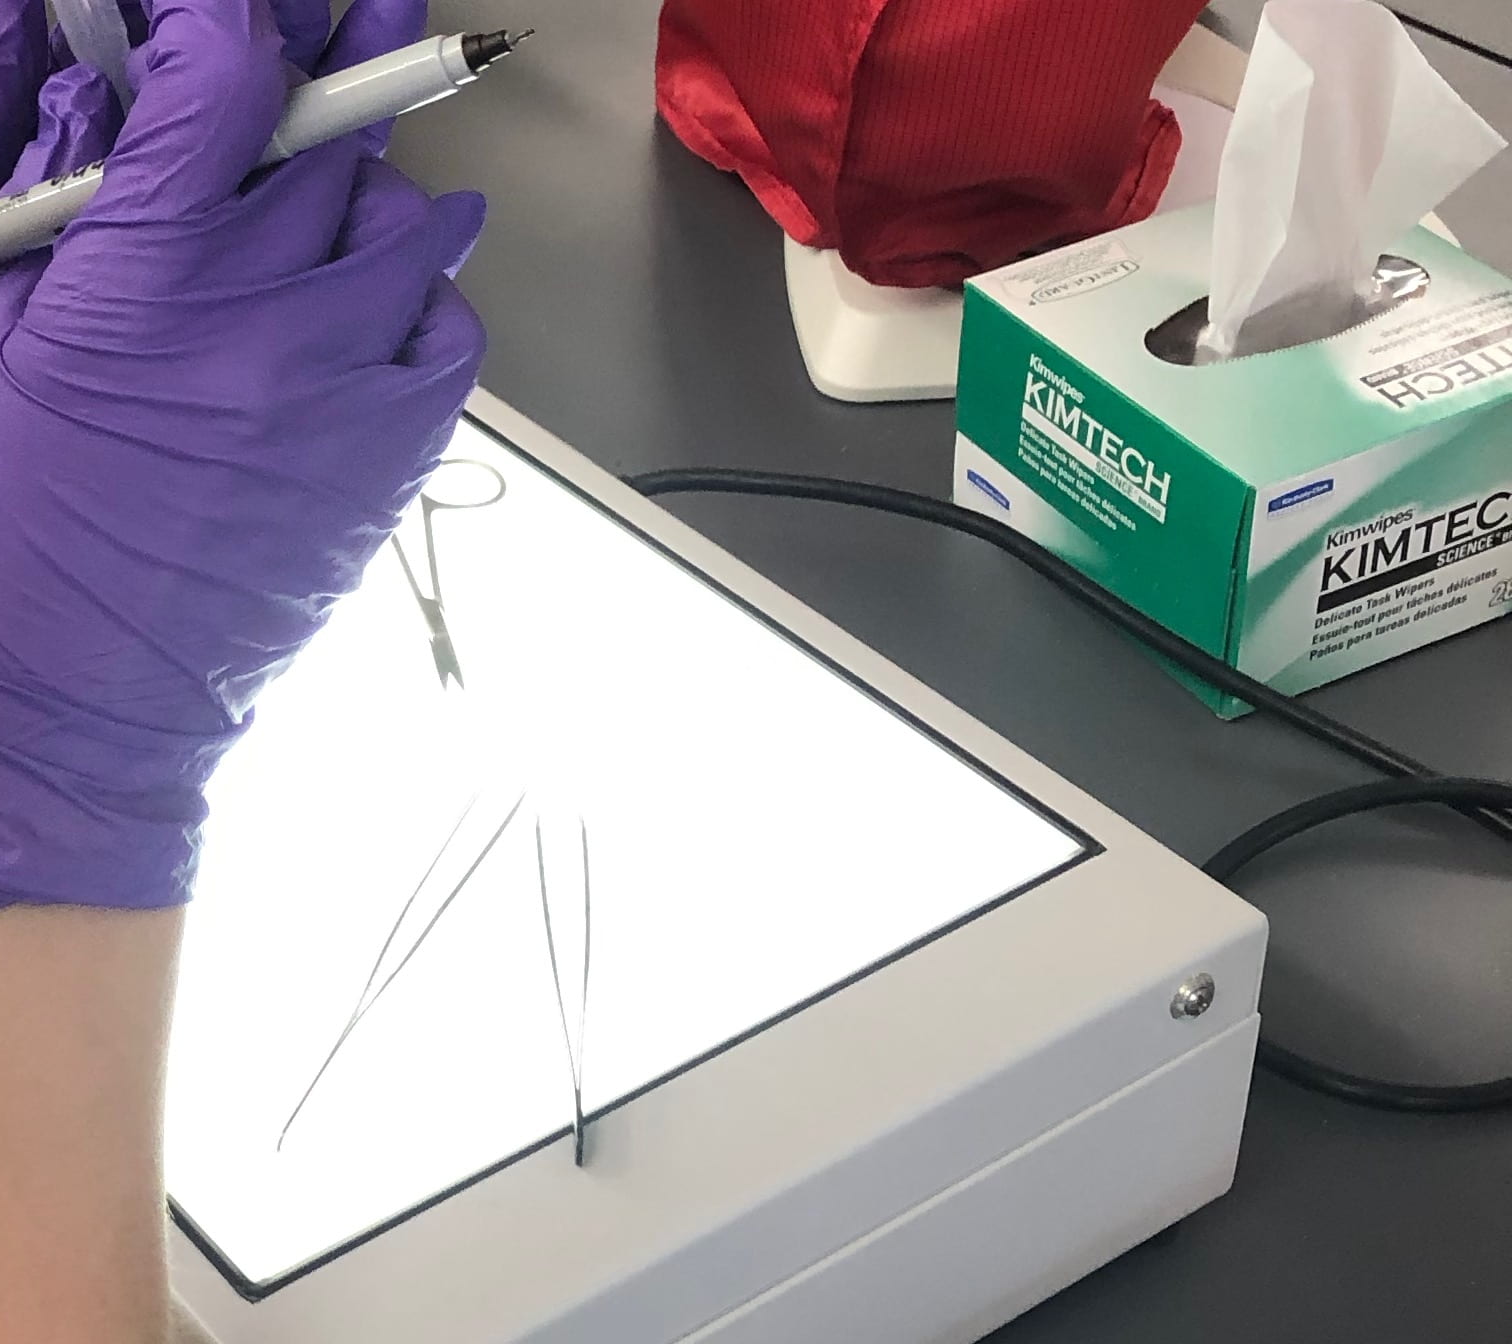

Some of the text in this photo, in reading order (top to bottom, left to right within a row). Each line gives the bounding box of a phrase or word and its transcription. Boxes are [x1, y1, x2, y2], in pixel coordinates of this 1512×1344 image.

[1030, 353, 1085, 404] Kimwipes
[1377, 346, 1512, 408] TECH
[1024, 371, 1171, 505] KIMTECH
[1095, 460, 1134, 498] SCIENCE
[1326, 507, 1414, 551] Kimwipes
[1436, 533, 1494, 568] SCIENCE
[1314, 576, 1436, 630] Delicate Task Wipers
[1346, 629, 1373, 650] para
[1375, 614, 1411, 636] tareas
[1413, 593, 1468, 622] delicadas
[1377, 604, 1404, 624] pour
